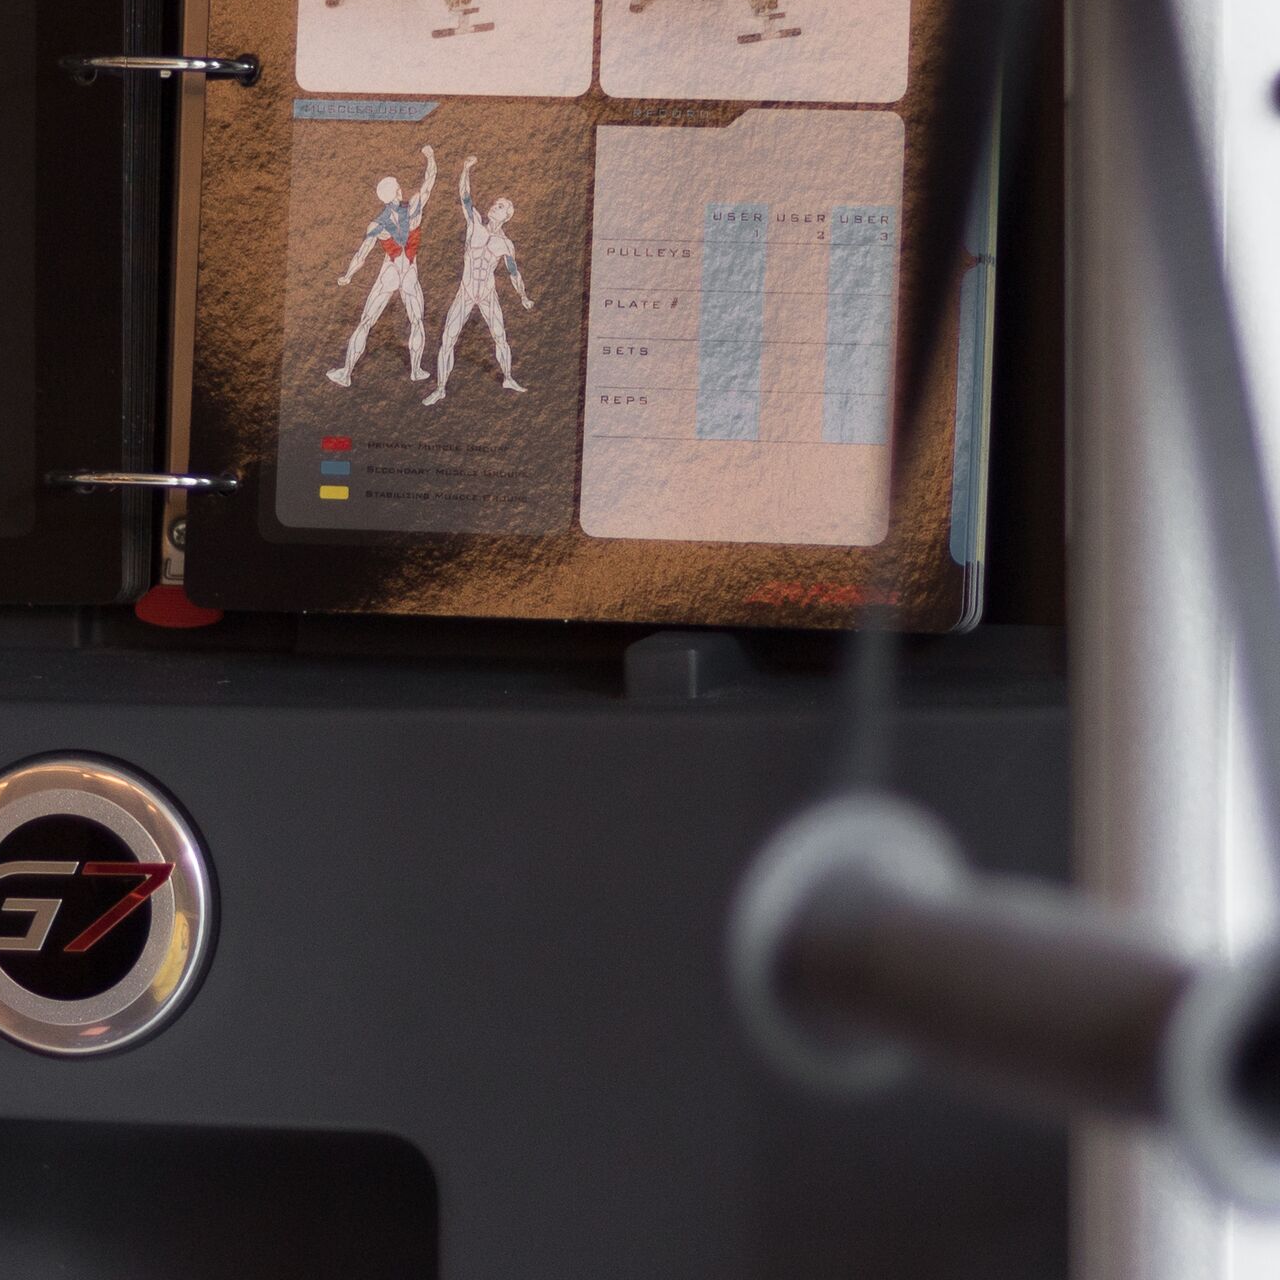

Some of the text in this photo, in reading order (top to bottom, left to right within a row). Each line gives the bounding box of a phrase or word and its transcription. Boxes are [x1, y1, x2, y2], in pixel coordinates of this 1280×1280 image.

[303, 104, 418, 117] MUSCLES USED
[712, 212, 889, 226] USER USER USER
[816, 230, 825, 241] 2
[879, 231, 889, 242] 3
[606, 247, 691, 258] PULLEYS
[604, 296, 680, 310] PLATE #
[602, 345, 649, 356] SETS
[600, 394, 649, 405] REPS
